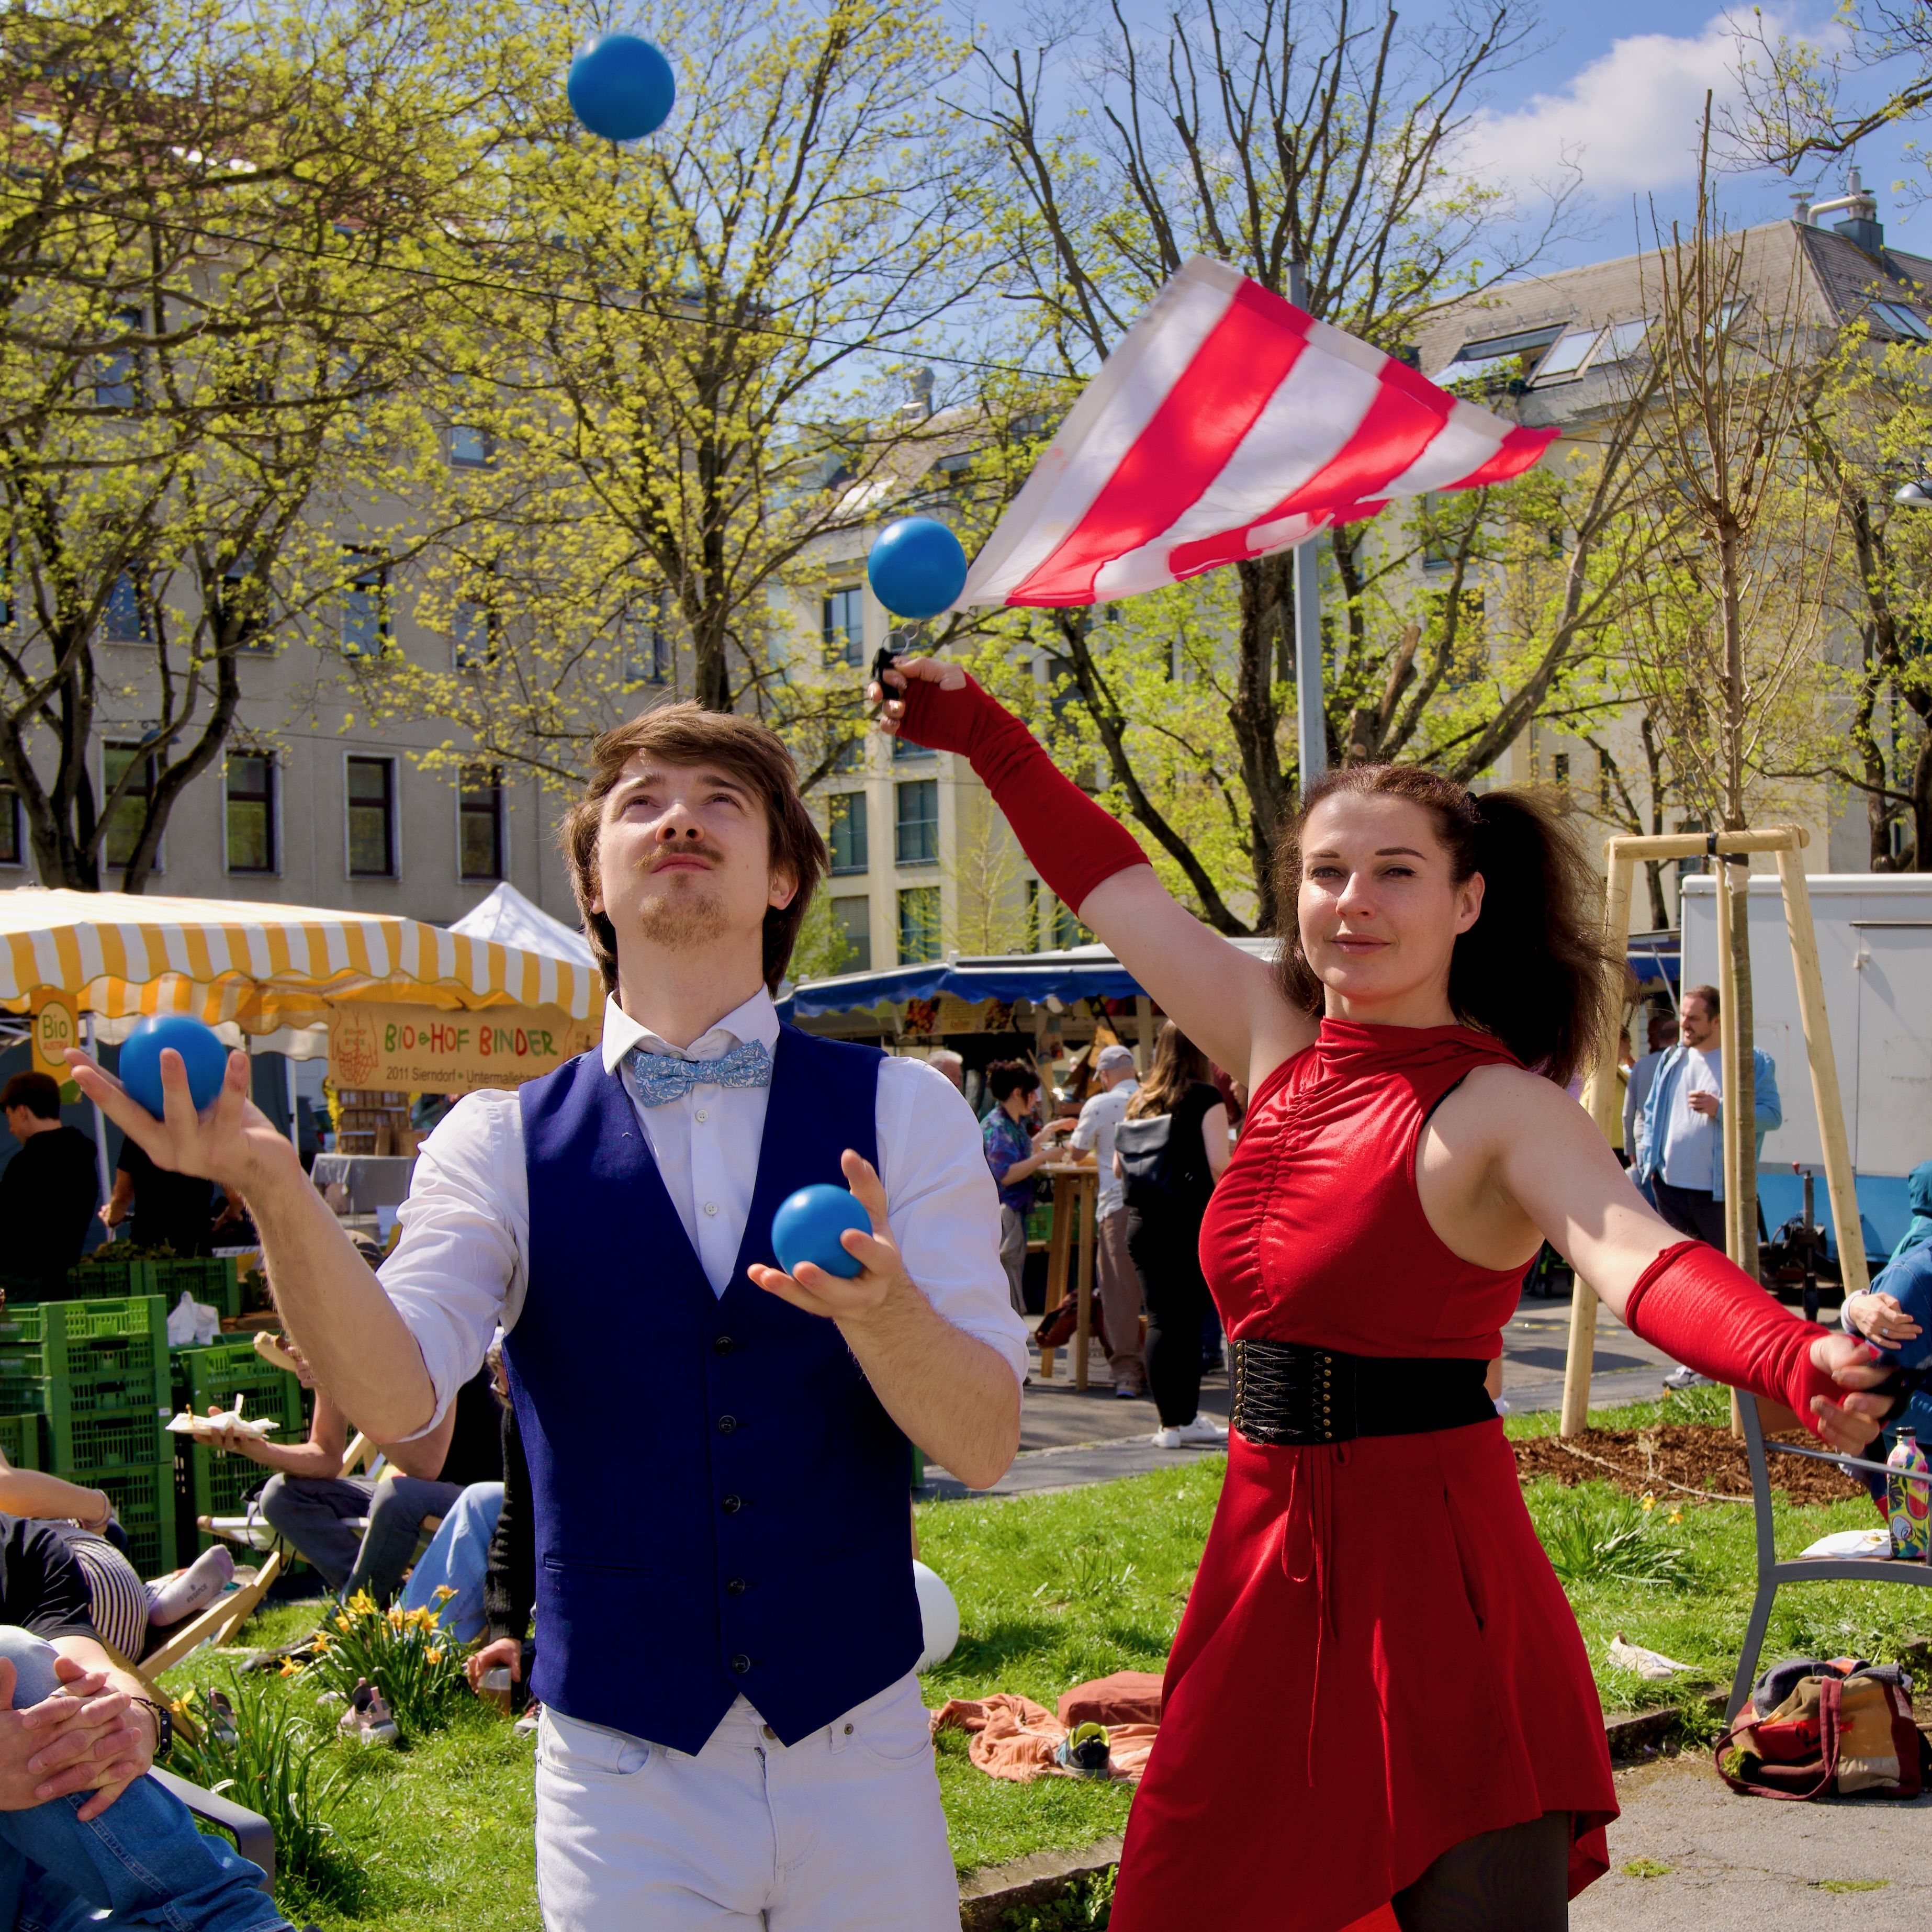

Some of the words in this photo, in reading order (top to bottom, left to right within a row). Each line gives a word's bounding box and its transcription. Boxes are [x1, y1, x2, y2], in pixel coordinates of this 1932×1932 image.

[43, 1014, 68, 1039] Bio
[385, 1023, 415, 1053] BIO
[430, 1022, 469, 1054] HOF
[479, 1025, 558, 1057] BINDER
[386, 1065, 409, 1081] 2011
[412, 1066, 456, 1083] Sierndorf
